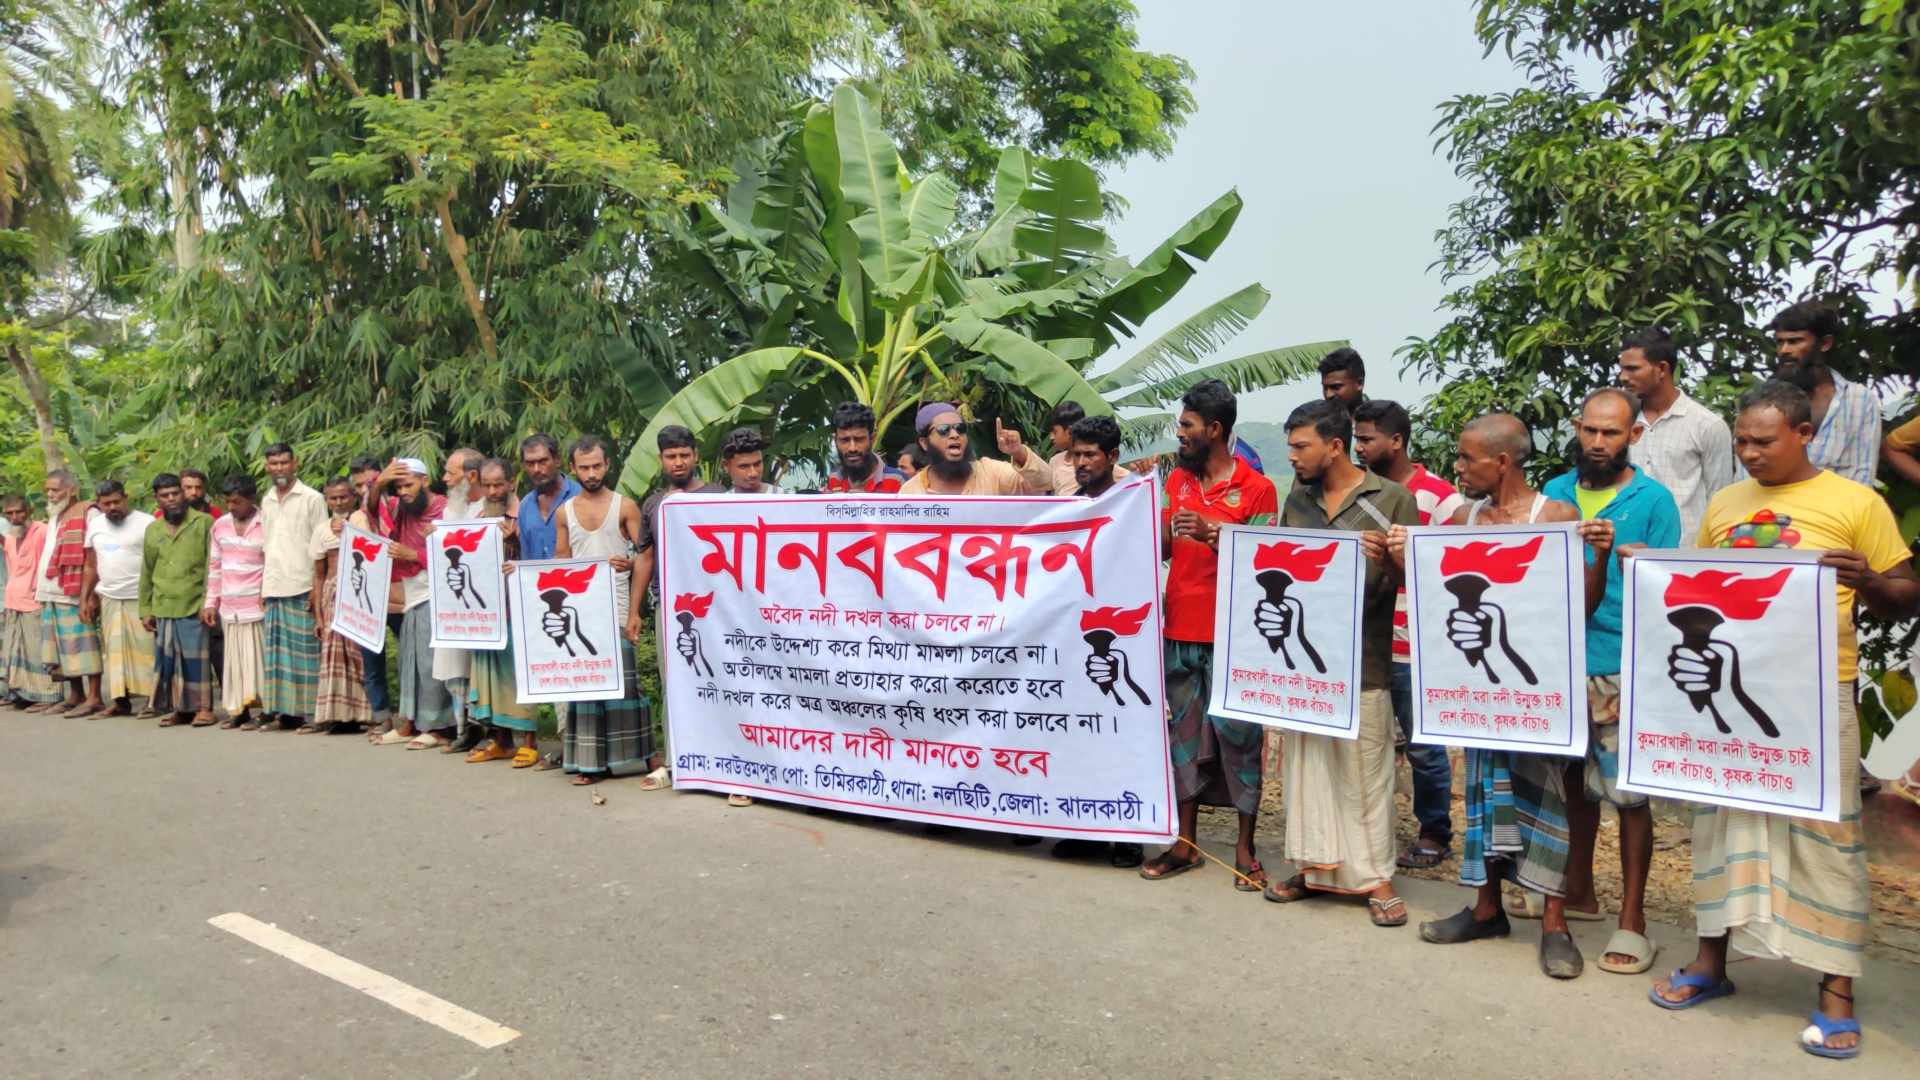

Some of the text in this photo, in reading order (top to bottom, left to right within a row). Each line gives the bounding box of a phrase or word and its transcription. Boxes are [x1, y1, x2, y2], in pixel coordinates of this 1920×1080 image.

[923, 504, 950, 518] রাহিম
[688, 515, 1113, 602] মানববন্ধন
[808, 603, 839, 627] নদী
[845, 610, 882, 628] দখল
[888, 611, 917, 630] করা
[924, 613, 972, 632] চলবে
[724, 629, 766, 650] নদীকে
[828, 639, 860, 656] করে
[868, 636, 910, 661] মিথ্যা
[916, 644, 964, 664] মামলা
[969, 645, 1019, 665] চলবে
[788, 664, 829, 687] মামলা
[835, 671, 904, 692] প্রত্যাহার
[953, 677, 1021, 696] করেতে
[1026, 679, 1064, 700] হবে
[1472, 691, 1488, 704] মরা
[1491, 688, 1509, 704] নদী
[1544, 692, 1562, 709] চাই
[696, 682, 719, 705] নদী
[723, 689, 753, 709] দখল
[761, 692, 791, 711] করে
[797, 694, 823, 713] অত্র
[827, 698, 887, 720] অঞ্চলের
[892, 700, 925, 730] কৃষি
[975, 707, 1008, 730] করা
[1014, 711, 1070, 733] চলবে
[1440, 711, 1457, 726] দেশ
[1494, 714, 1517, 734] কৃষক
[1520, 712, 1550, 732] বাঁচাও
[739, 722, 1051, 777] আমাদের দাবী মানতে হবে
[1637, 731, 1811, 767] কুমারখালী মরা নদী উন্মুক্ত চাই
[1652, 758, 1676, 776] দেশ
[1722, 767, 1753, 790] কৃষক
[1758, 768, 1794, 792] বাঁচাও
